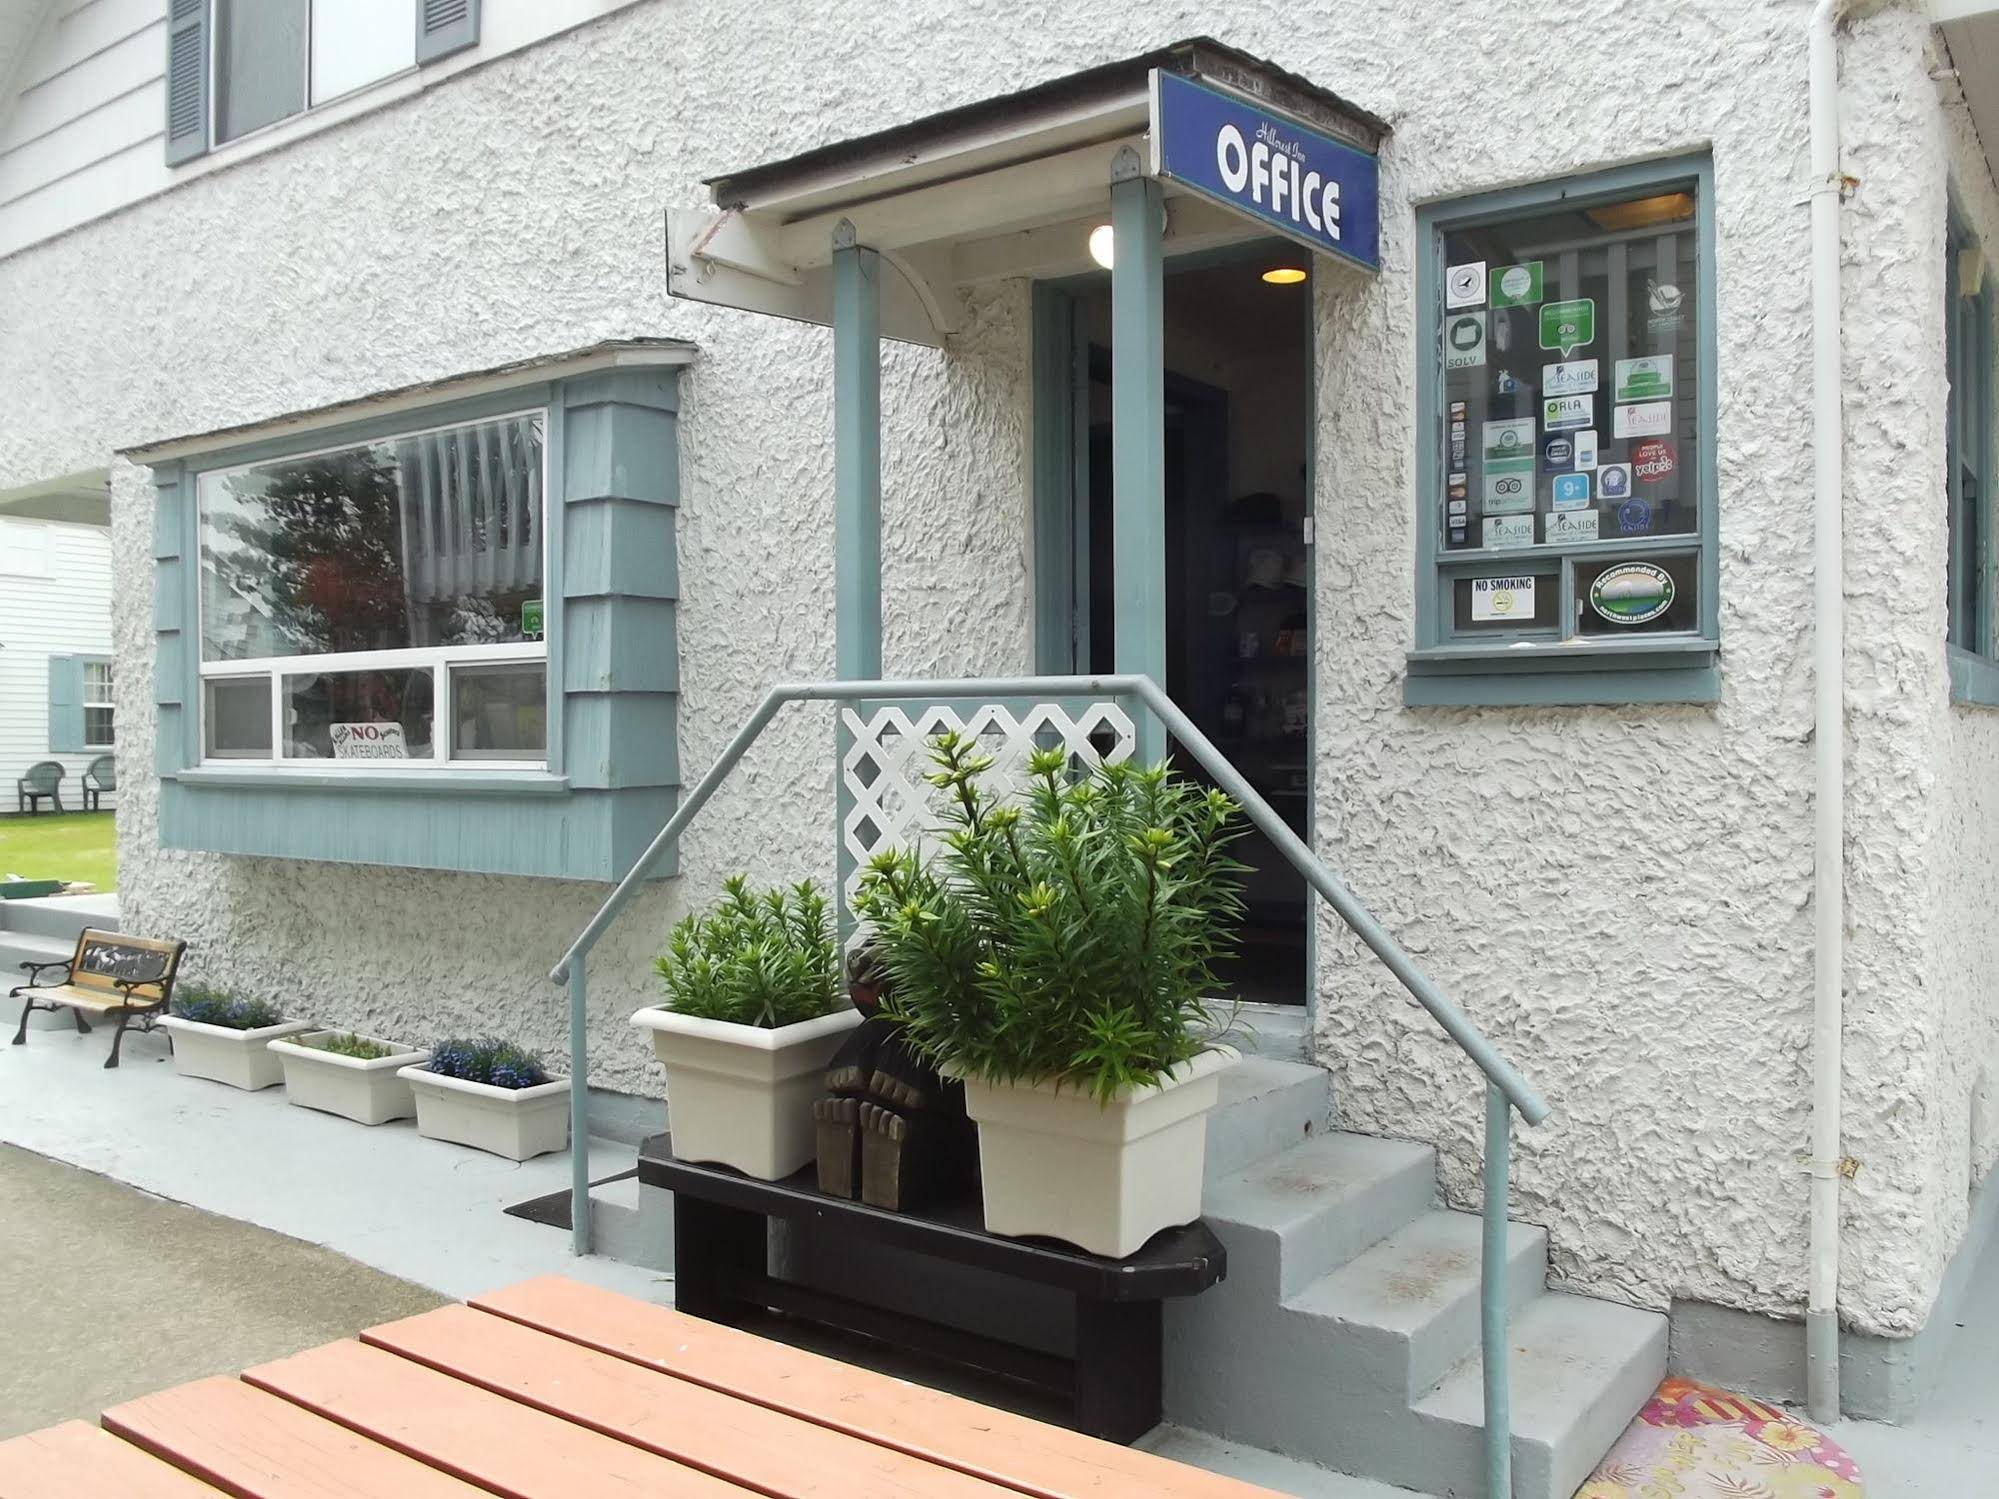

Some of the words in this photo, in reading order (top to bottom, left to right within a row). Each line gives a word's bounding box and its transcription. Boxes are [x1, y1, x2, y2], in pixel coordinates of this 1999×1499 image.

[1292, 142, 1306, 162] Inn
[1216, 124, 1341, 240] OFFICE
[1448, 356, 1476, 368] SOLV
[1555, 369, 1596, 384] SEASIDE
[1635, 461, 1661, 476] yelp
[1495, 525, 1532, 536] SEASIDE
[1558, 519, 1597, 532] SEASIDE
[1475, 580, 1488, 592] NO
[1490, 578, 1532, 591] SMOKING
[1596, 566, 1658, 589] Recommended
[1656, 573, 1668, 585] By
[1599, 599, 1668, 621] northwestplaces.com
[350, 725, 379, 741] NO
[338, 744, 404, 759] SKATEBOARDS
